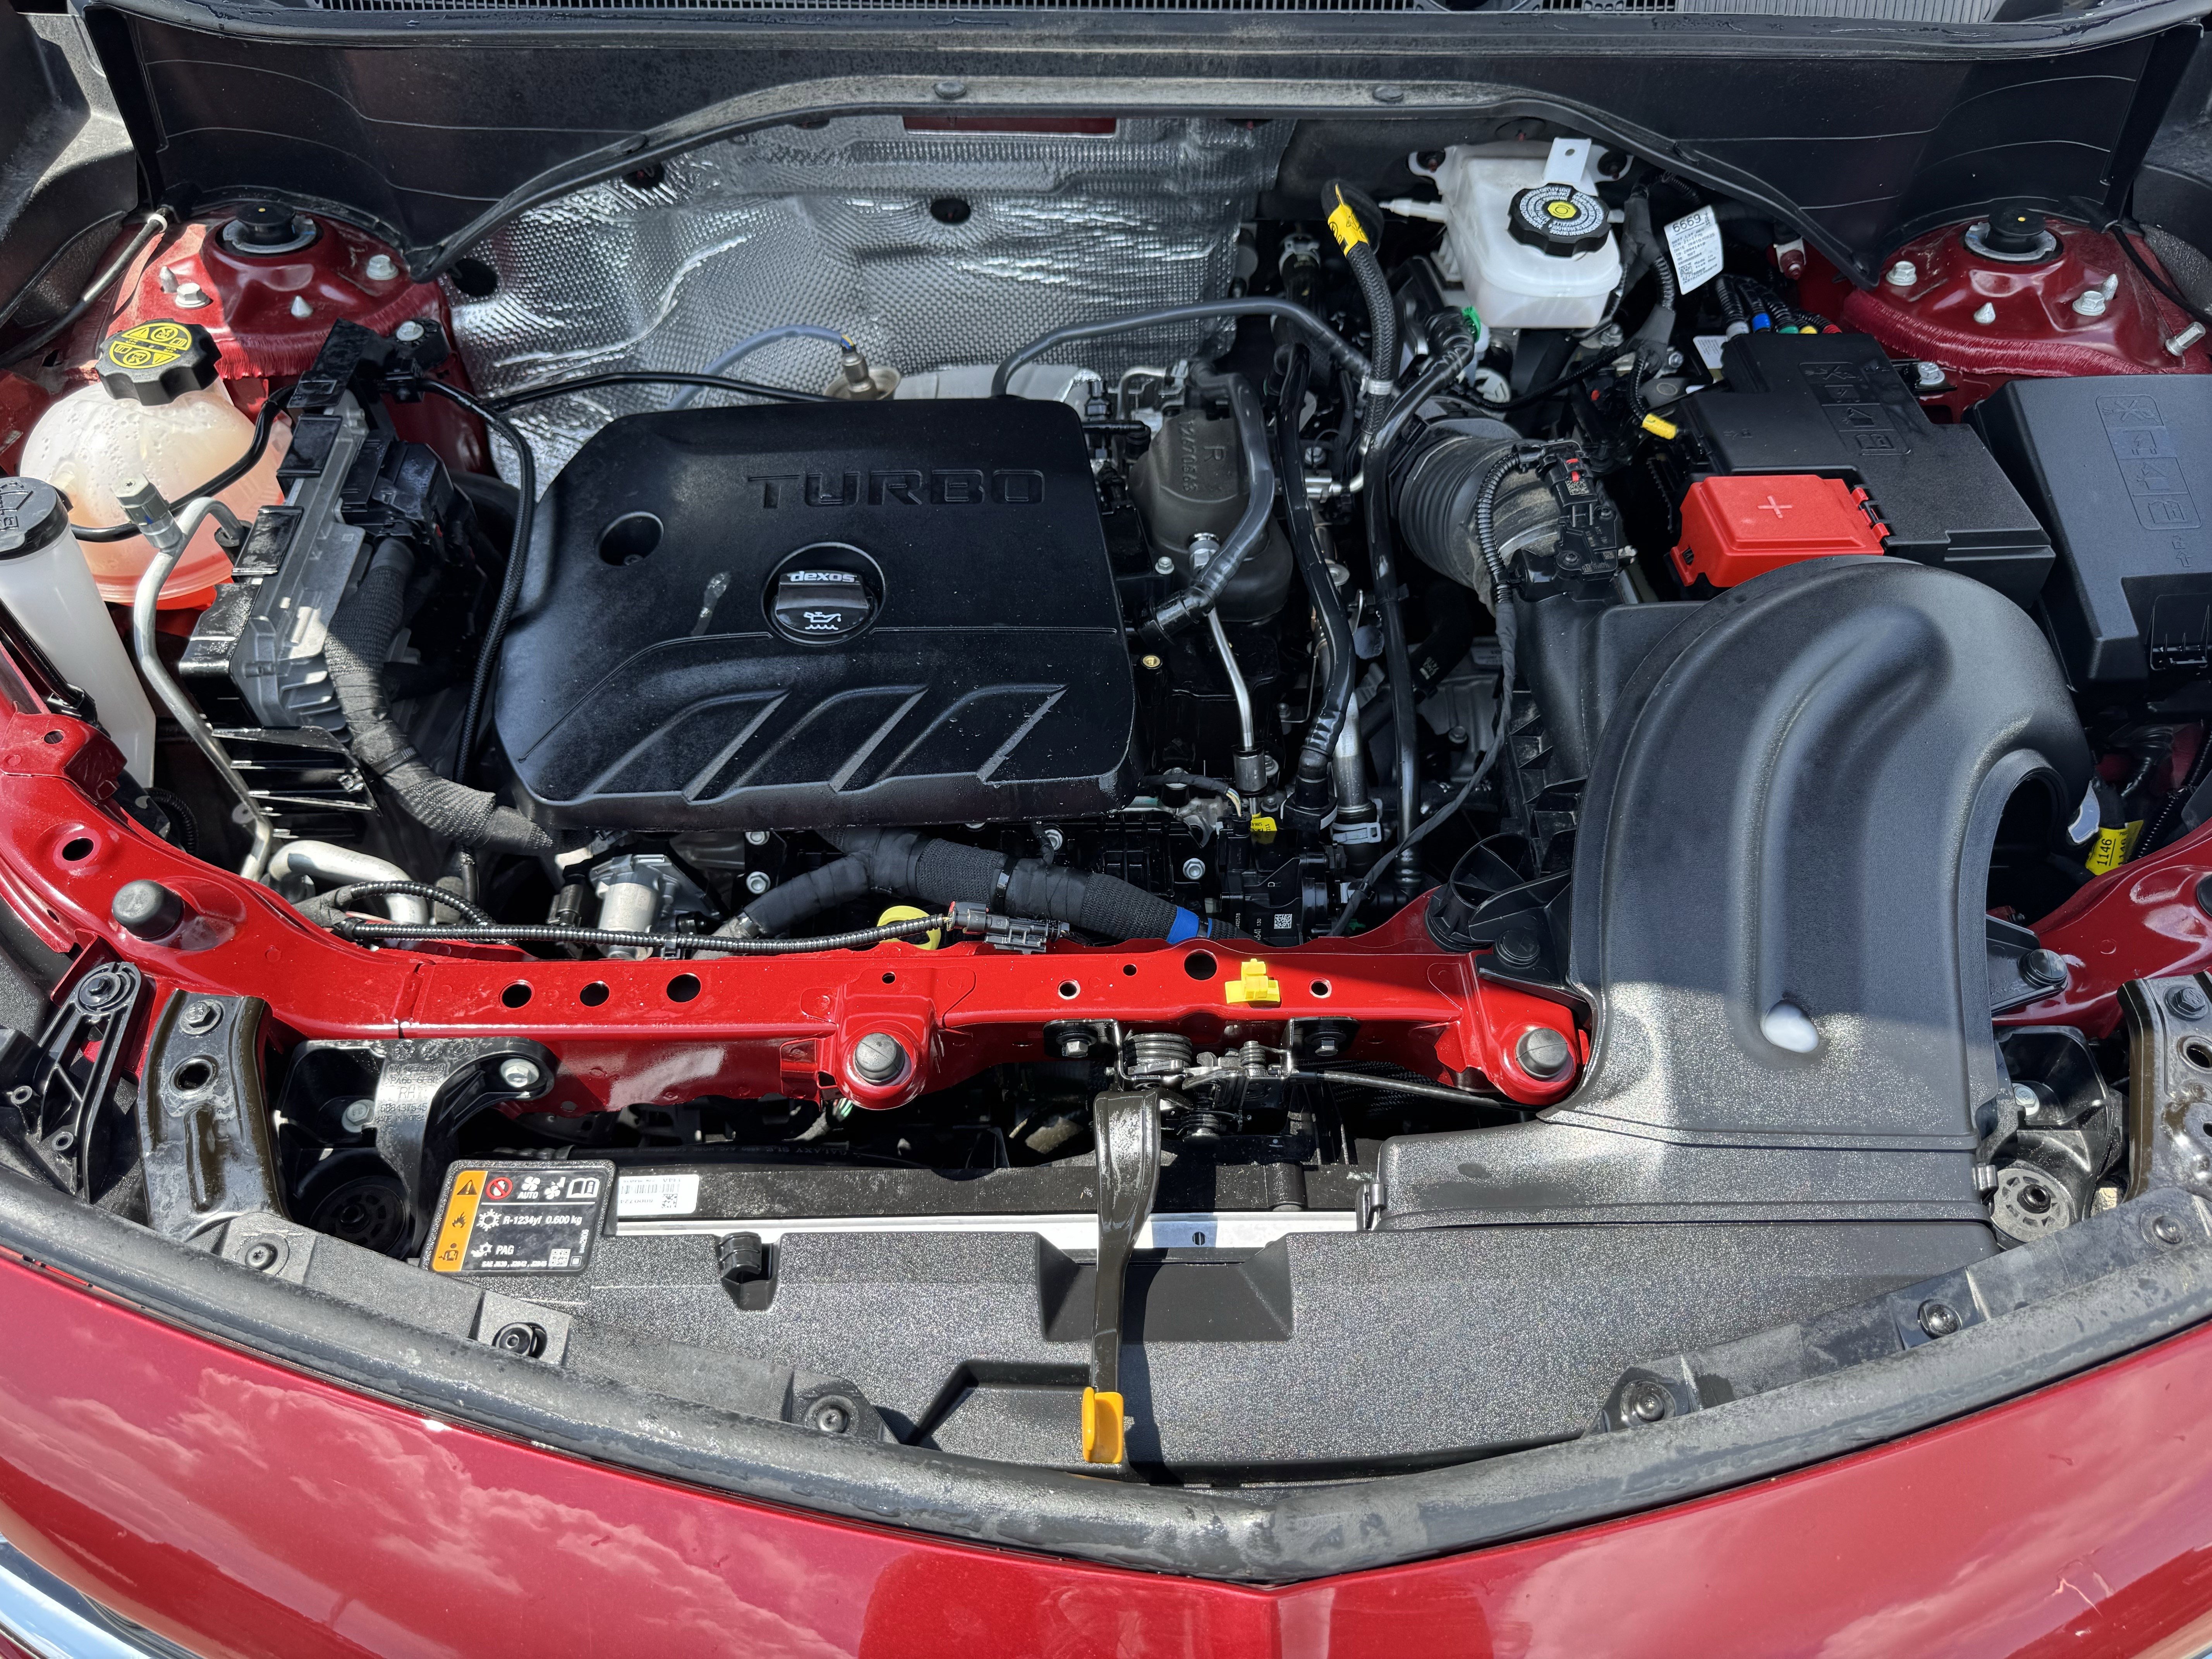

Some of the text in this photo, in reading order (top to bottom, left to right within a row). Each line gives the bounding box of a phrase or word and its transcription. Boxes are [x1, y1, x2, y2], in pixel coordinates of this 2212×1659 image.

[1673, 214, 1701, 232] 6669
[1203, 446, 1226, 462] R
[748, 469, 1045, 509] TURBO
[790, 571, 855, 582] dexos
[2097, 838, 2112, 865] 1146
[399, 1084, 416, 1098] RH
[503, 1215, 582, 1226] R-1234yf 0.600 kg
[495, 1245, 514, 1255] PAG
